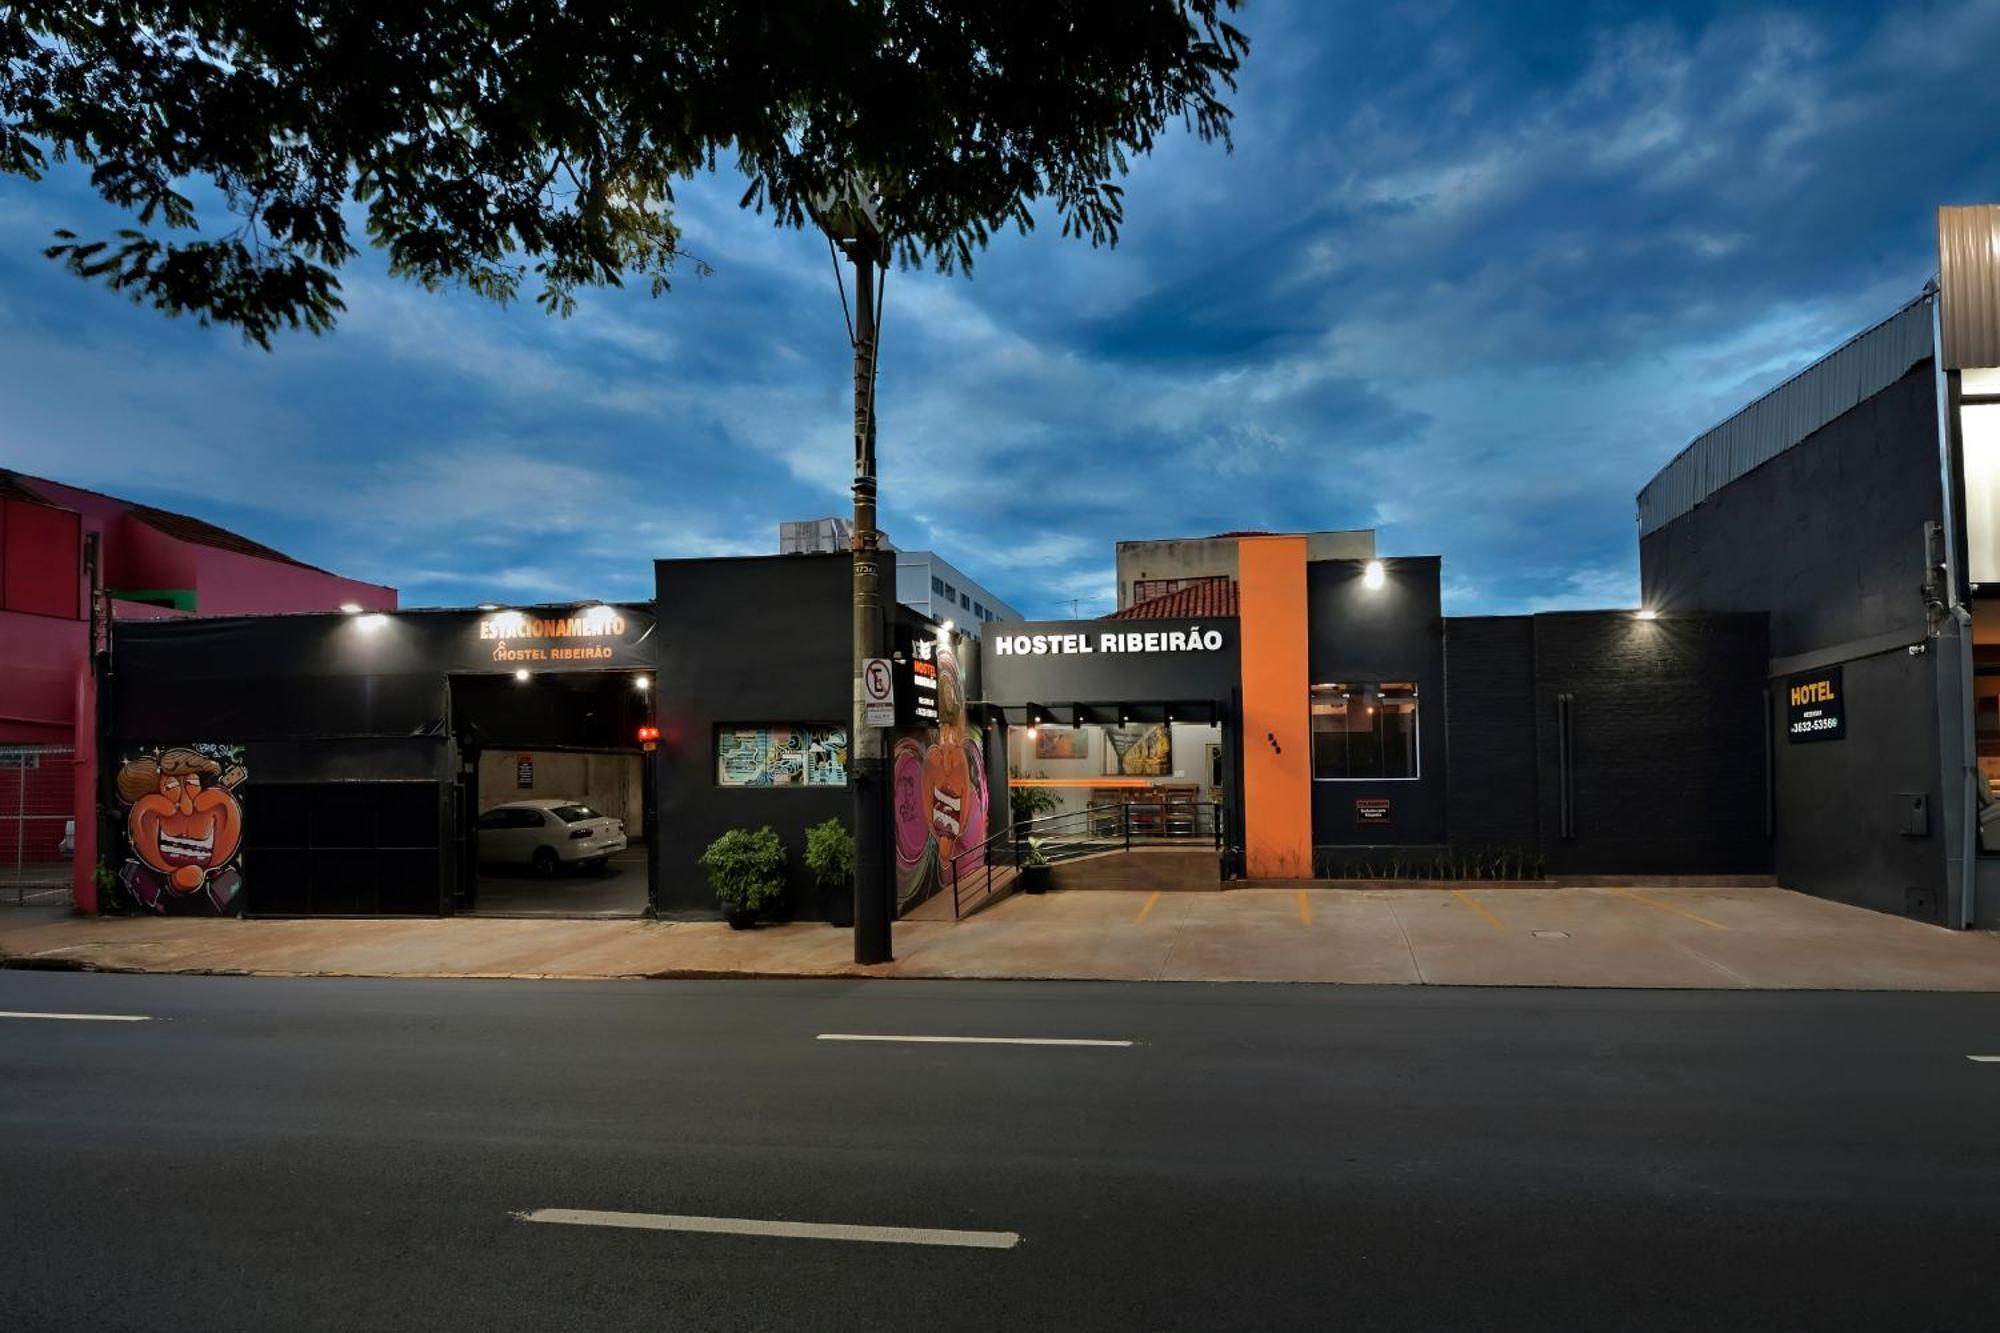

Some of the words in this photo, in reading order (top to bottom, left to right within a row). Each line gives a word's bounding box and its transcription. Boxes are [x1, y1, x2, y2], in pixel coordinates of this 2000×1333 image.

[480, 615, 626, 640] ESTACIONAMENTO
[995, 634, 1093, 655] HOSTEL
[1100, 626, 1223, 653] RIBEIRÃO
[498, 649, 547, 661] HOSTEL
[551, 646, 612, 660] RIBEIRÃO
[914, 660, 937, 677] HOSTEL
[1791, 680, 1835, 706] HOTEL
